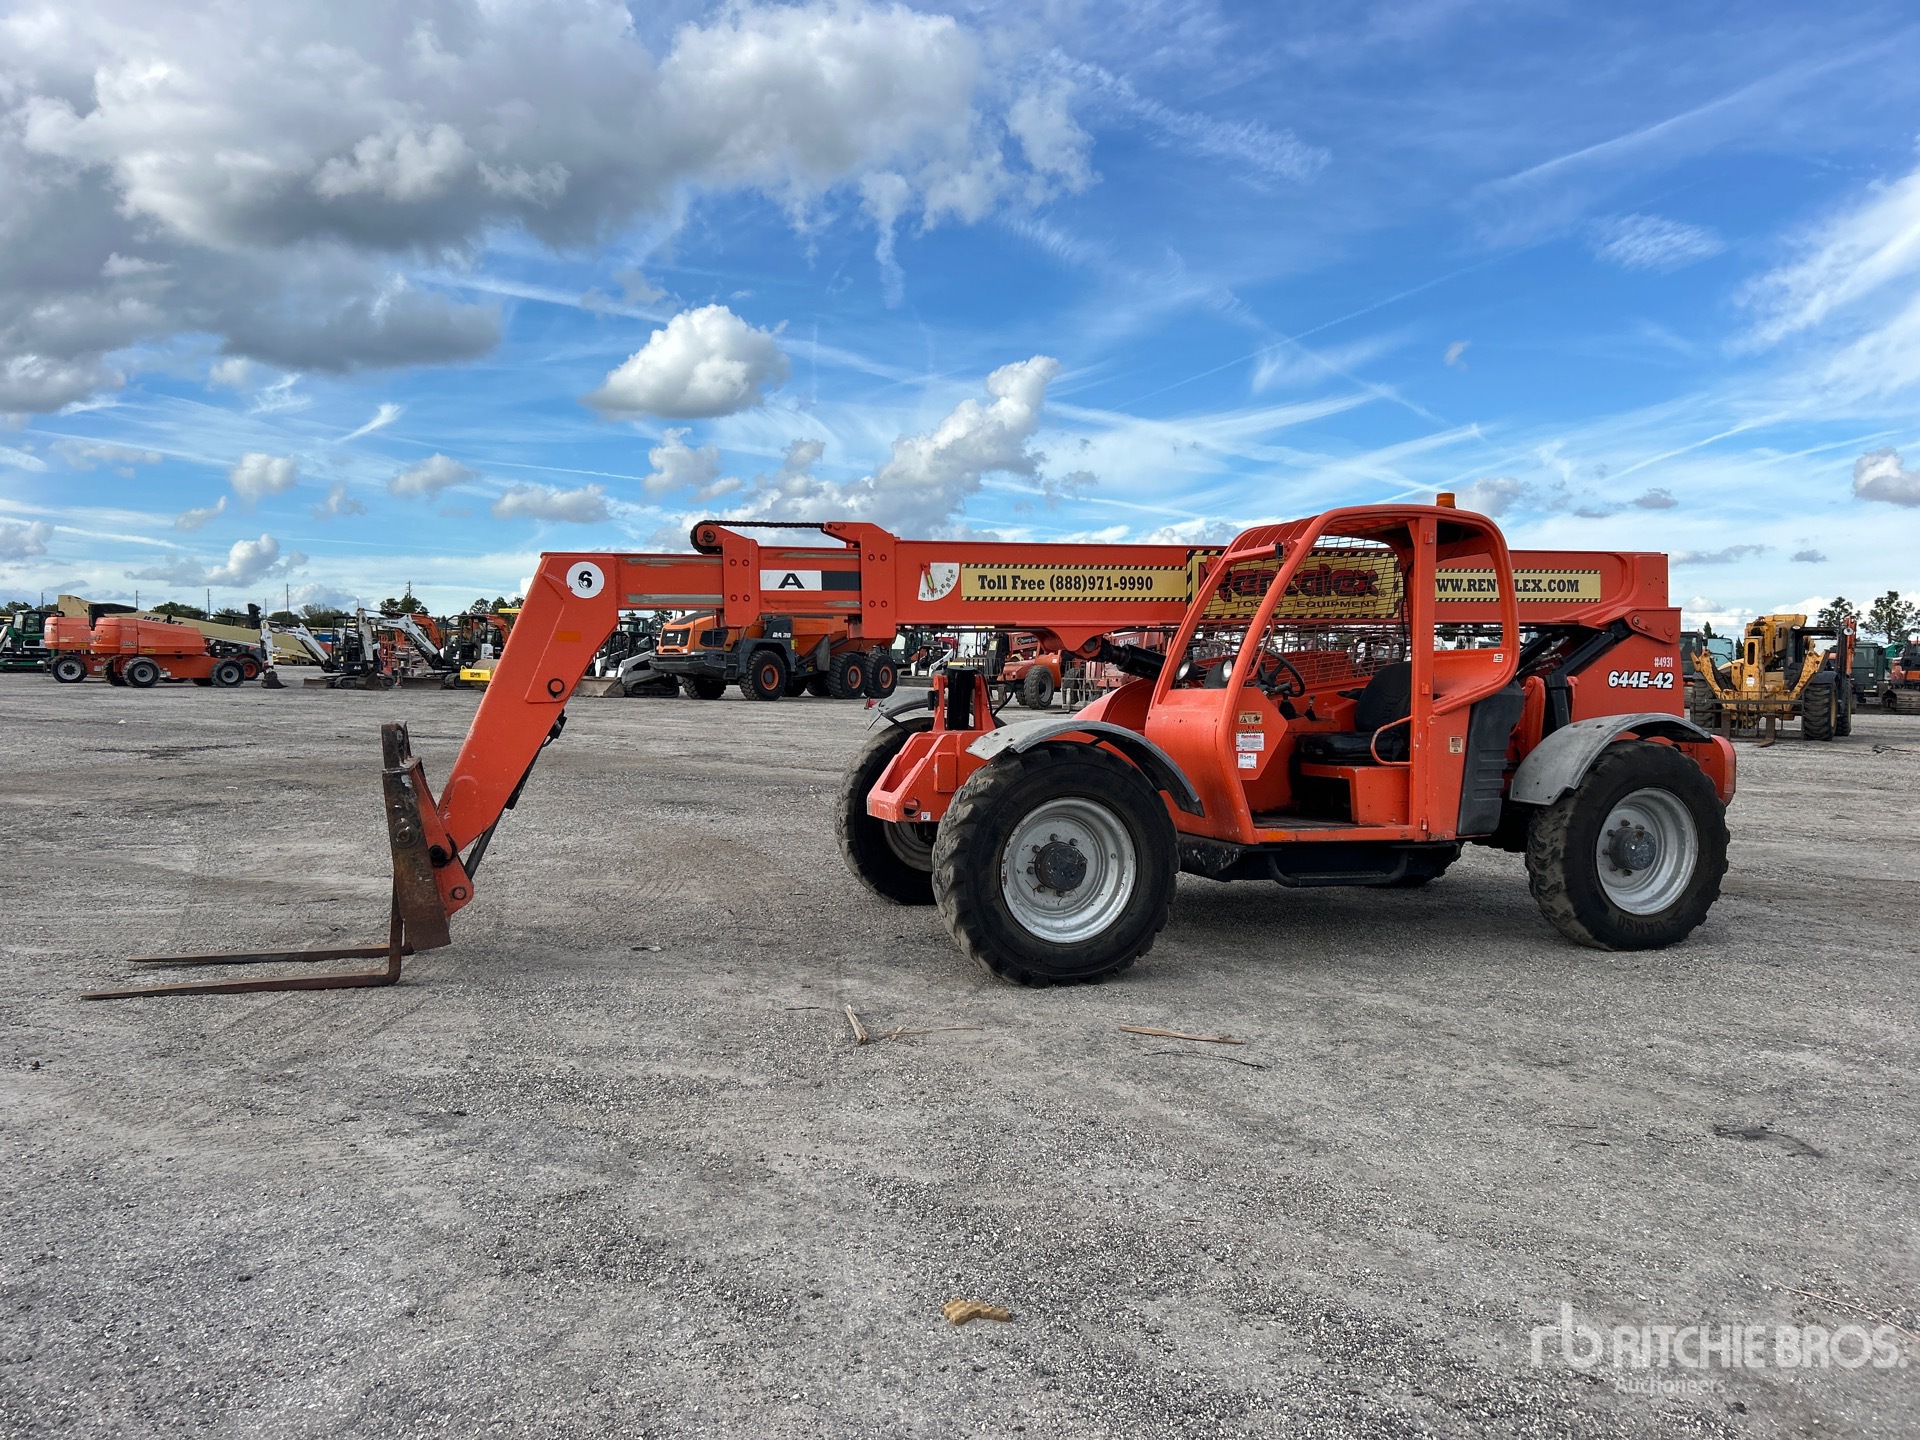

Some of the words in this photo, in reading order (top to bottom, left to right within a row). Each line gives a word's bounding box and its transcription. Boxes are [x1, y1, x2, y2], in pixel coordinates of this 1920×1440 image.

[578, 570, 593, 589] 6
[778, 573, 805, 589] A
[978, 575, 1007, 590] Toll
[1011, 575, 1045, 590] Free
[1050, 574, 1153, 592] (888)971-9990
[1654, 656, 1673, 667] #4931
[1608, 670, 1674, 689] 644E-42
